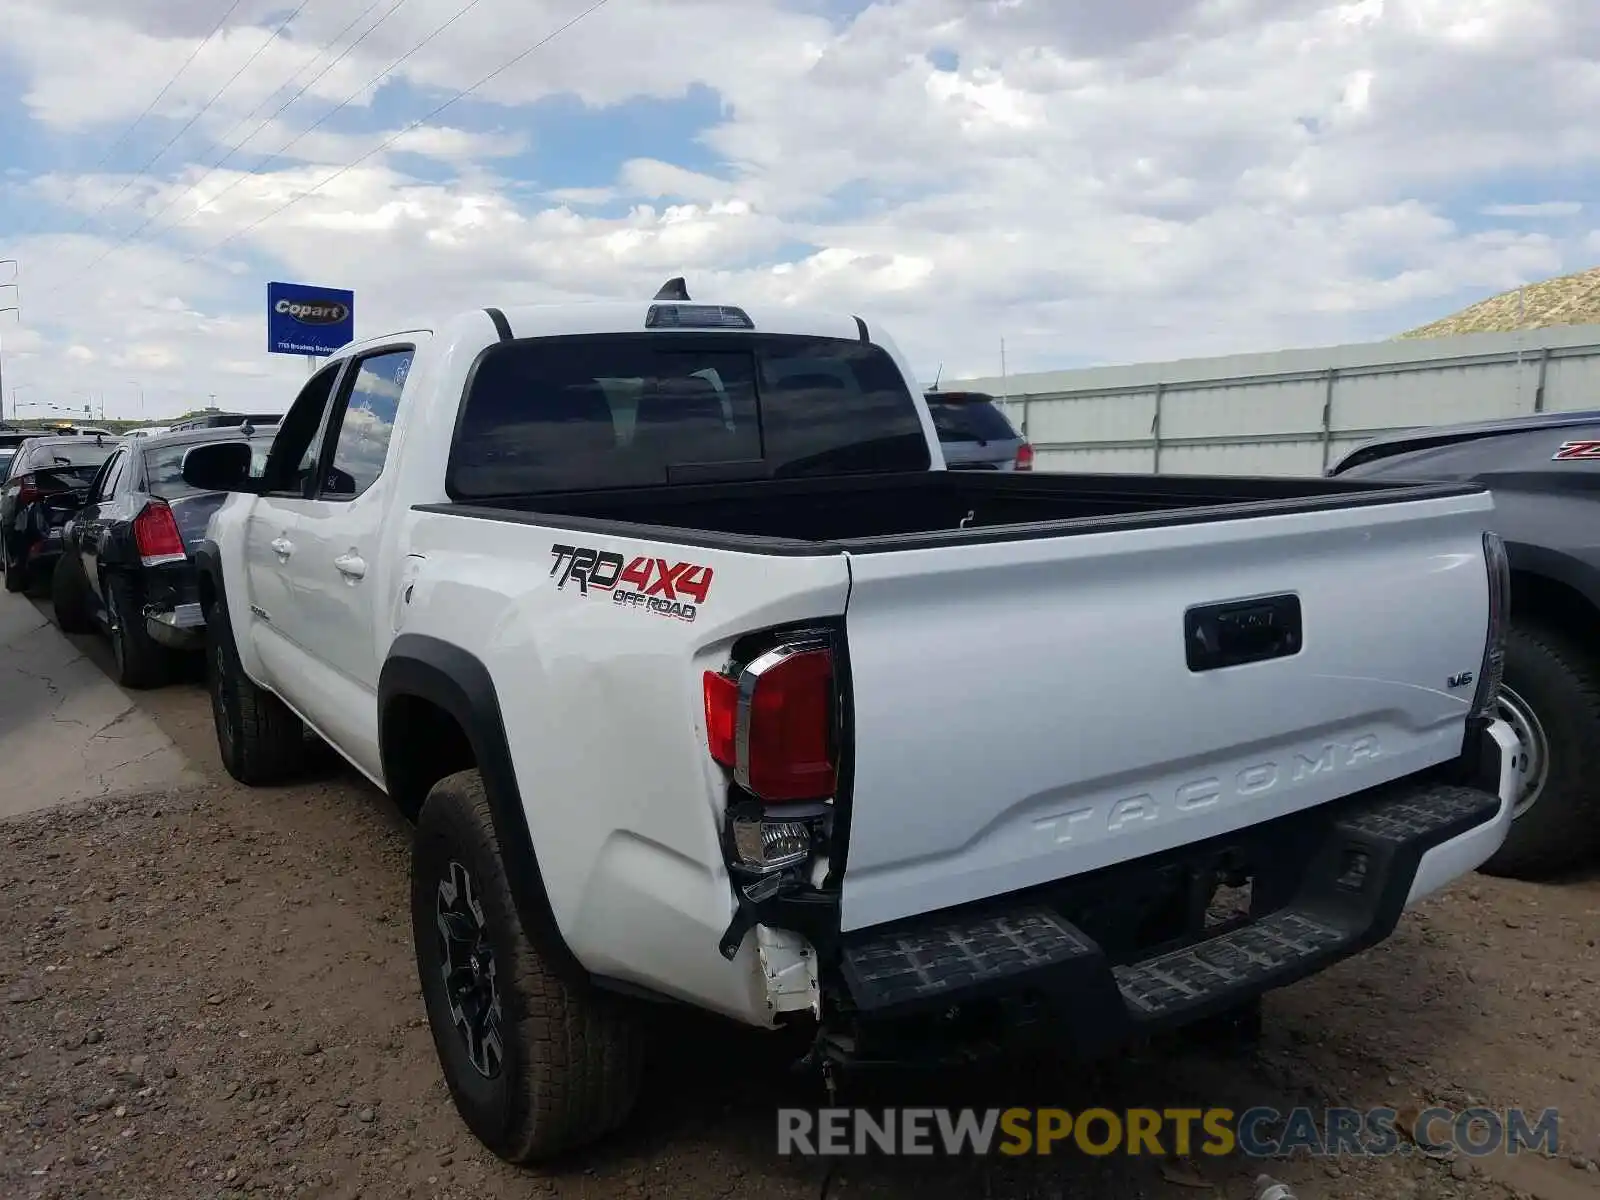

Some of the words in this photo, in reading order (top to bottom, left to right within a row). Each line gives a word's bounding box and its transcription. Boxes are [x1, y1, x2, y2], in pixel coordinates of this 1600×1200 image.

[275, 299, 340, 319] Copart
[550, 544, 624, 597] TRD
[1448, 672, 1472, 687] V6
[1033, 732, 1380, 843] TACOMA
